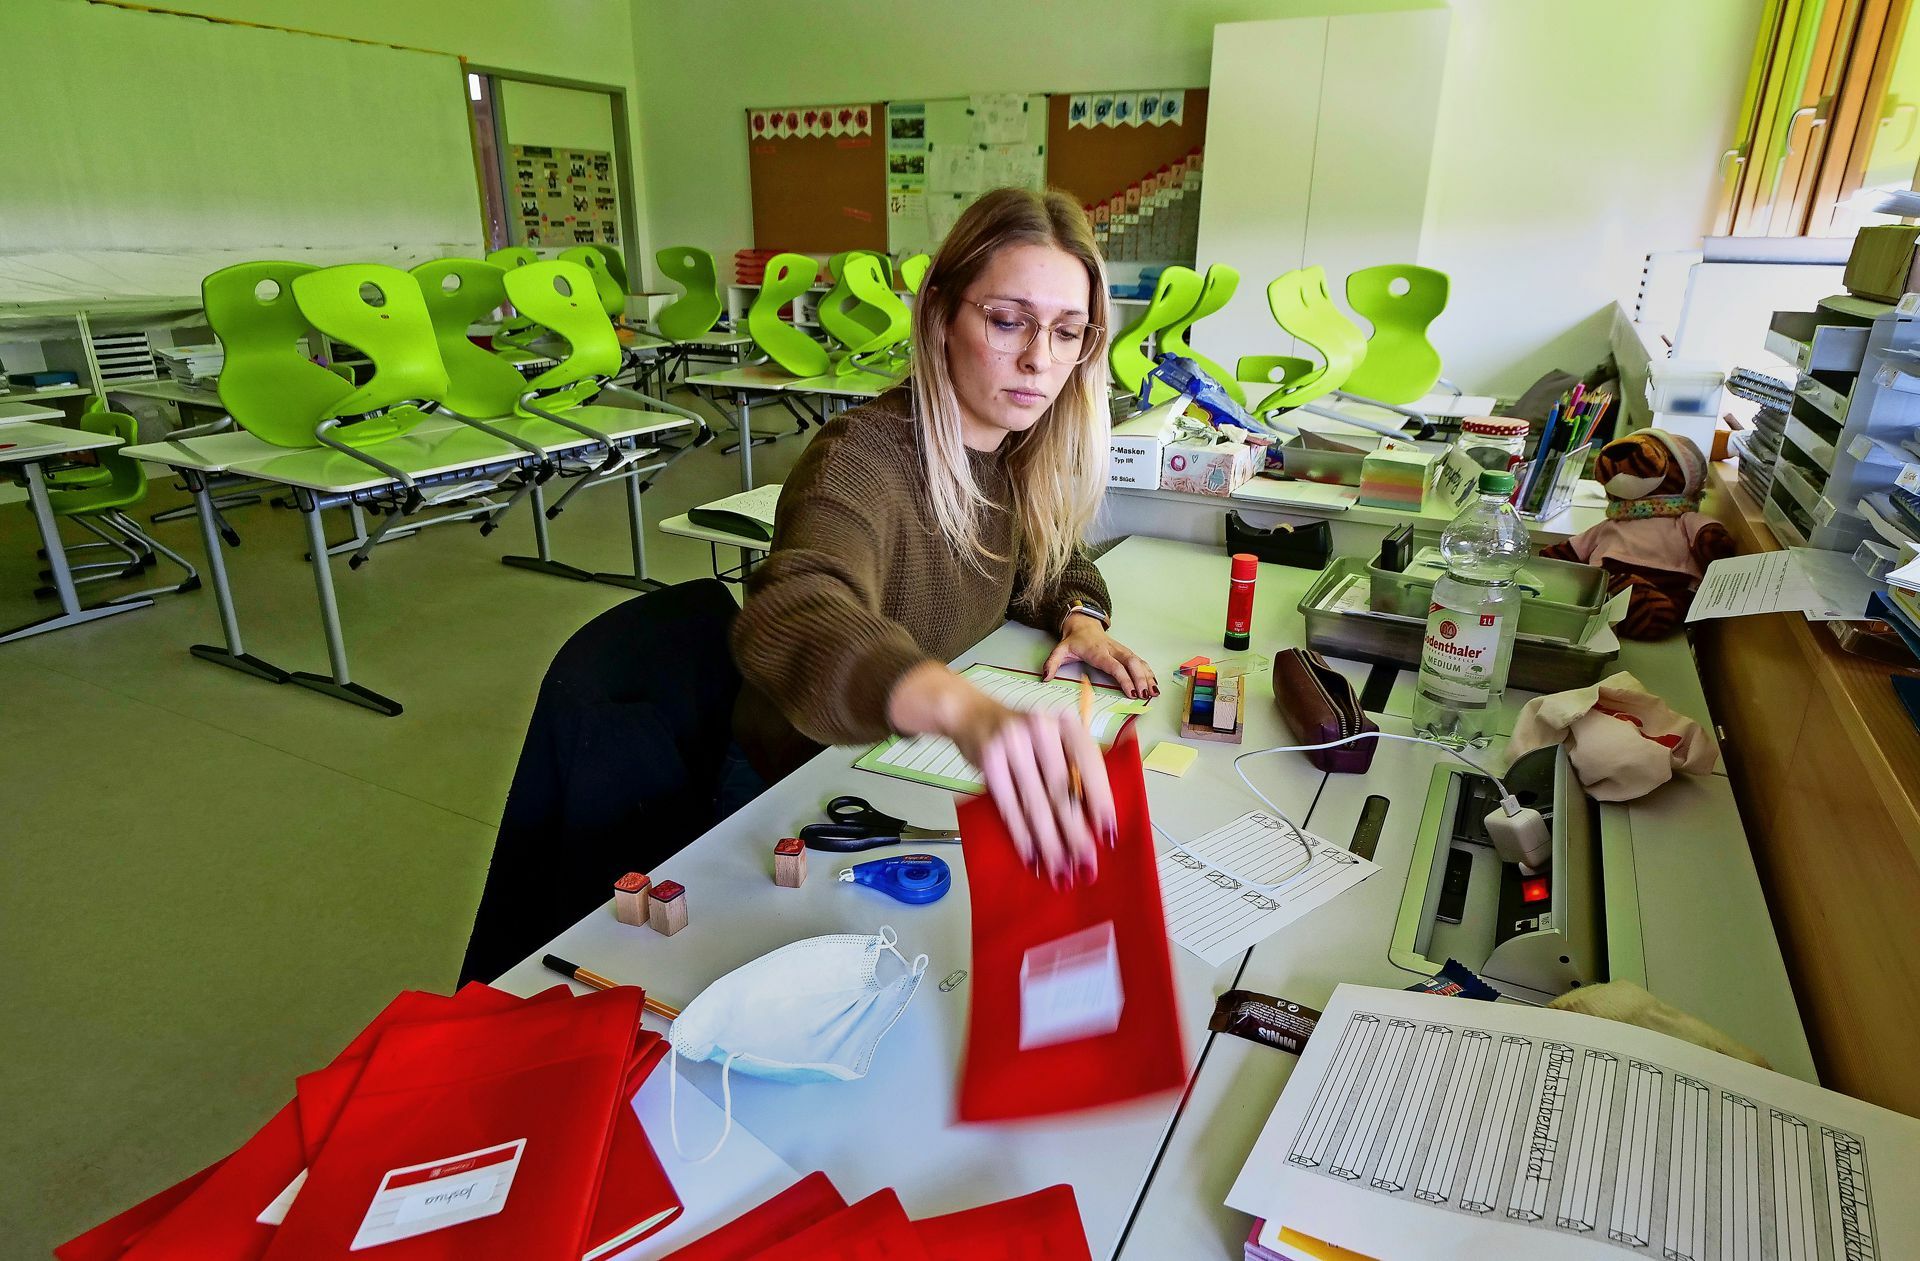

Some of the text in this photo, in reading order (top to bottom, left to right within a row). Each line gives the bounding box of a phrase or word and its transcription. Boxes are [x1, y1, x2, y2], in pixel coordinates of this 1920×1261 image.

[1074, 98, 1176, 117] Mathe
[1427, 655, 1461, 673] MEDIUM
[1258, 1026, 1297, 1051] MINIS
[1526, 1051, 1573, 1182] Buchstabendiktat
[424, 1182, 479, 1206] Joshua
